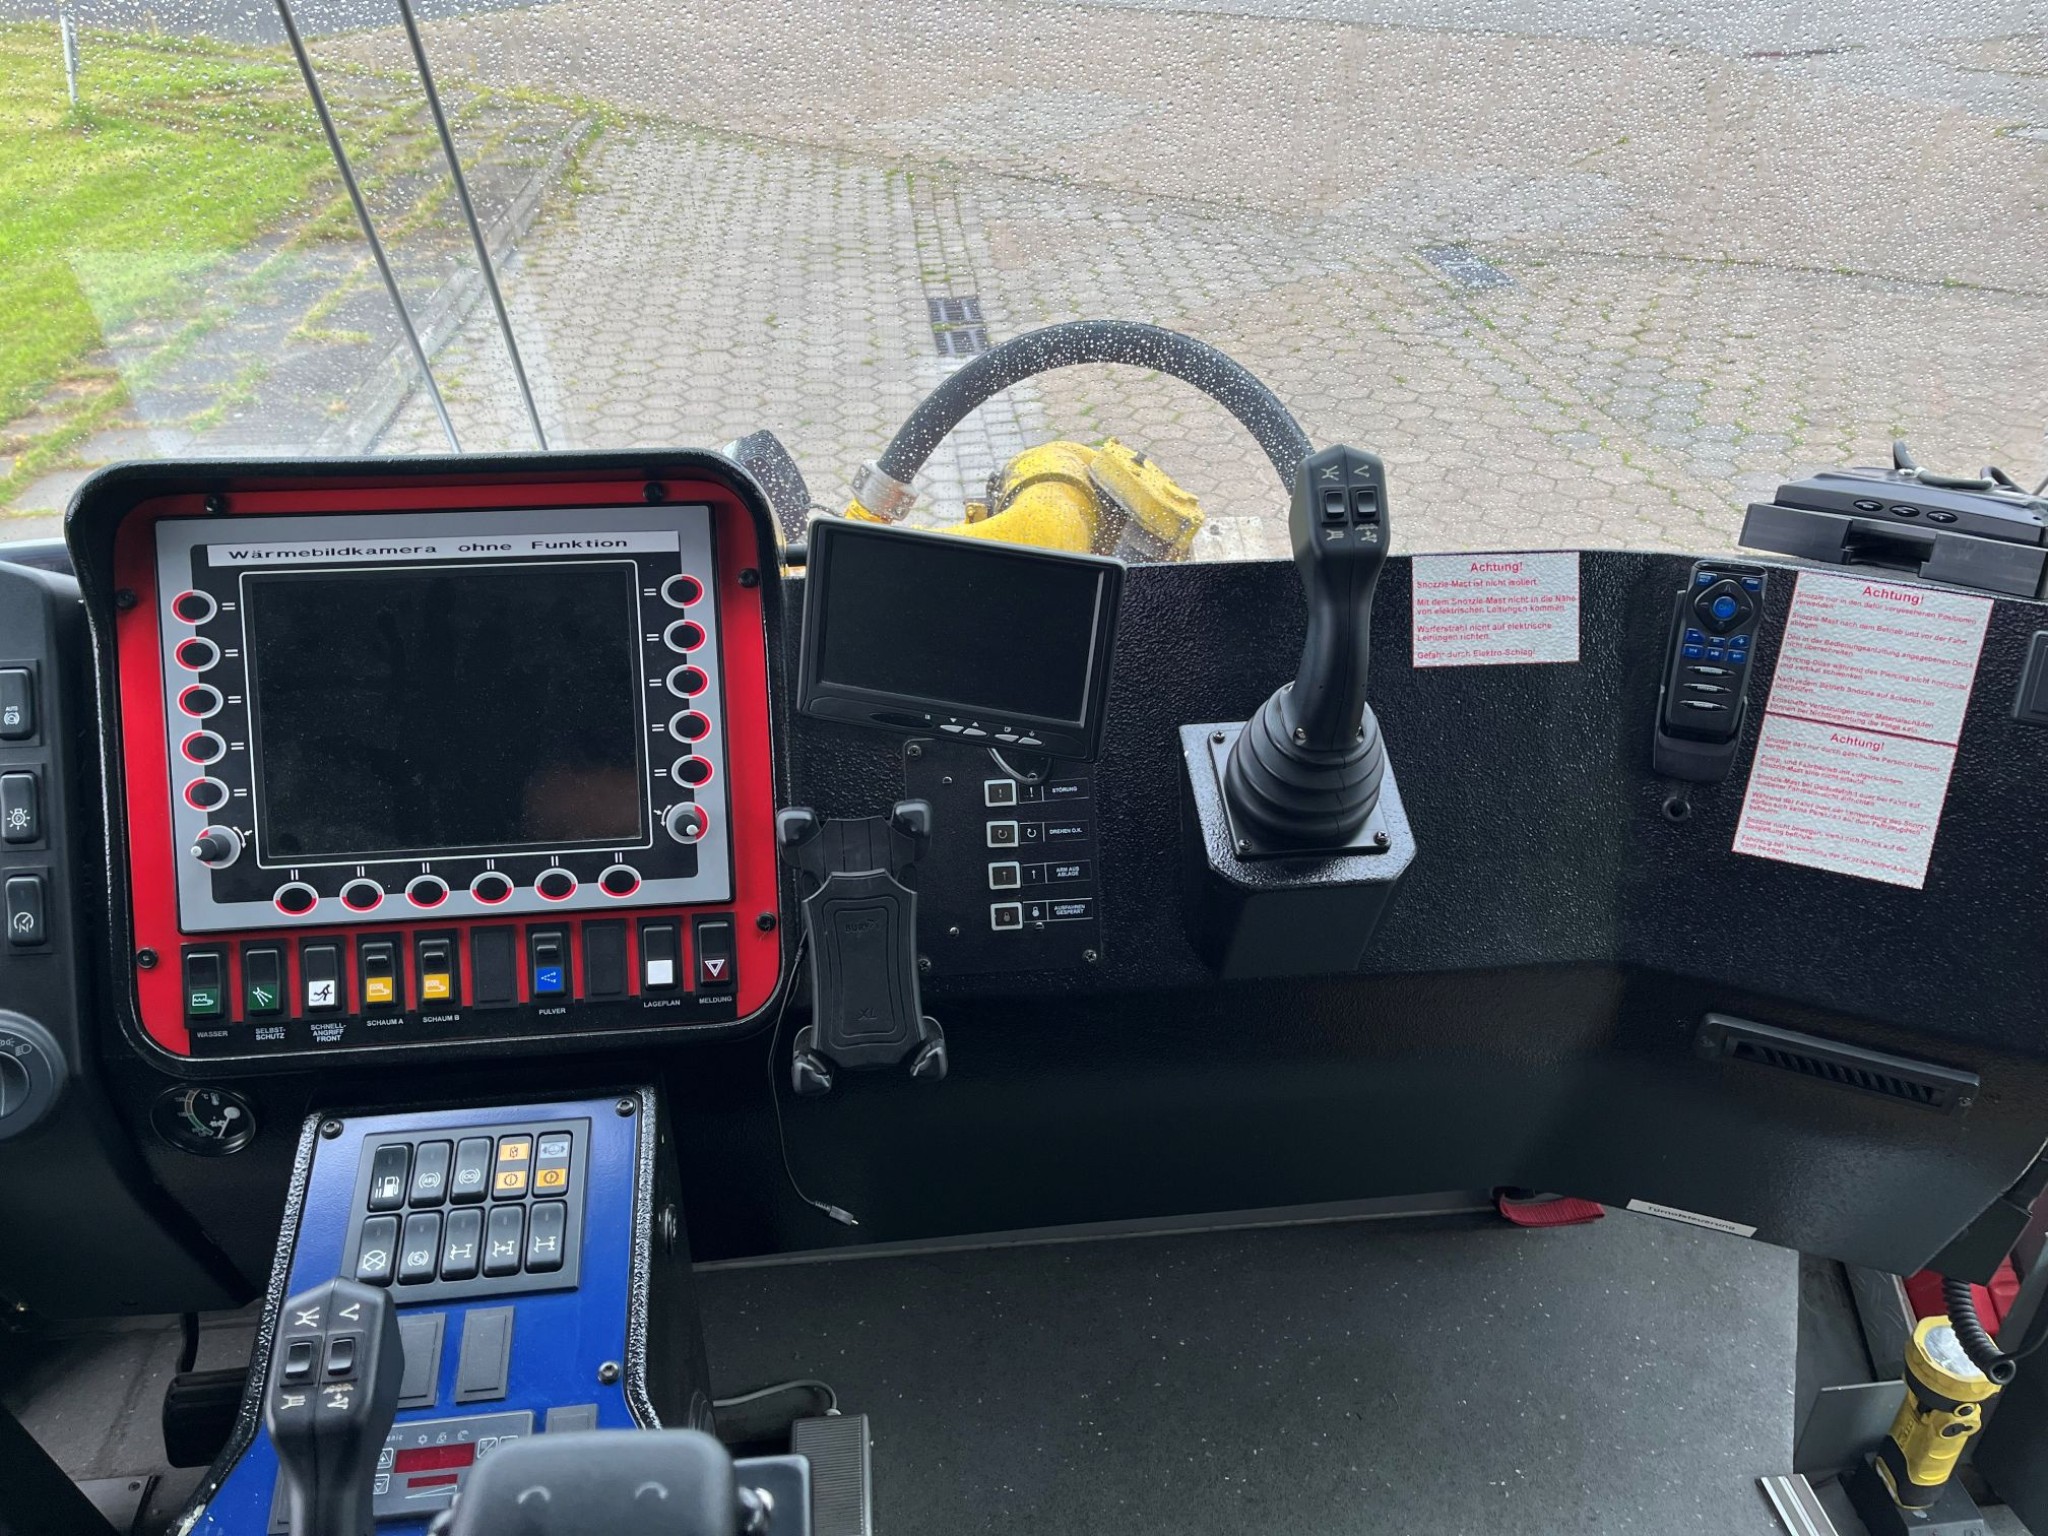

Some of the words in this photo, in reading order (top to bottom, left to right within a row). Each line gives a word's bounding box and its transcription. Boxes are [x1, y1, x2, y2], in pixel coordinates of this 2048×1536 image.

[228, 543, 437, 560] Wärmebildkamera
[457, 541, 512, 553] ohne
[530, 538, 628, 551] Funktion
[1470, 561, 1522, 574] Achtung!
[1485, 578, 1506, 587] nicht
[1861, 585, 1924, 606] Achtung!
[1416, 597, 1429, 606] Mit
[1507, 595, 1528, 603] nicht
[1540, 594, 1552, 602] die
[1416, 607, 1431, 616] von
[1829, 731, 1885, 752] Achtung!
[643, 1000, 681, 1008] LAGEPLAN
[699, 996, 732, 1004] MELDUNG
[538, 1007, 566, 1015] PULVER
[366, 1018, 396, 1026] SCHAUM
[422, 1015, 453, 1023] SCHAUM
[255, 1027, 286, 1035] SELBST-
[310, 1023, 347, 1031] SCHNELL-
[197, 1030, 229, 1038] WASSER
[255, 1033, 285, 1041] SCHUTZ
[312, 1029, 345, 1037] ANGRIFF
